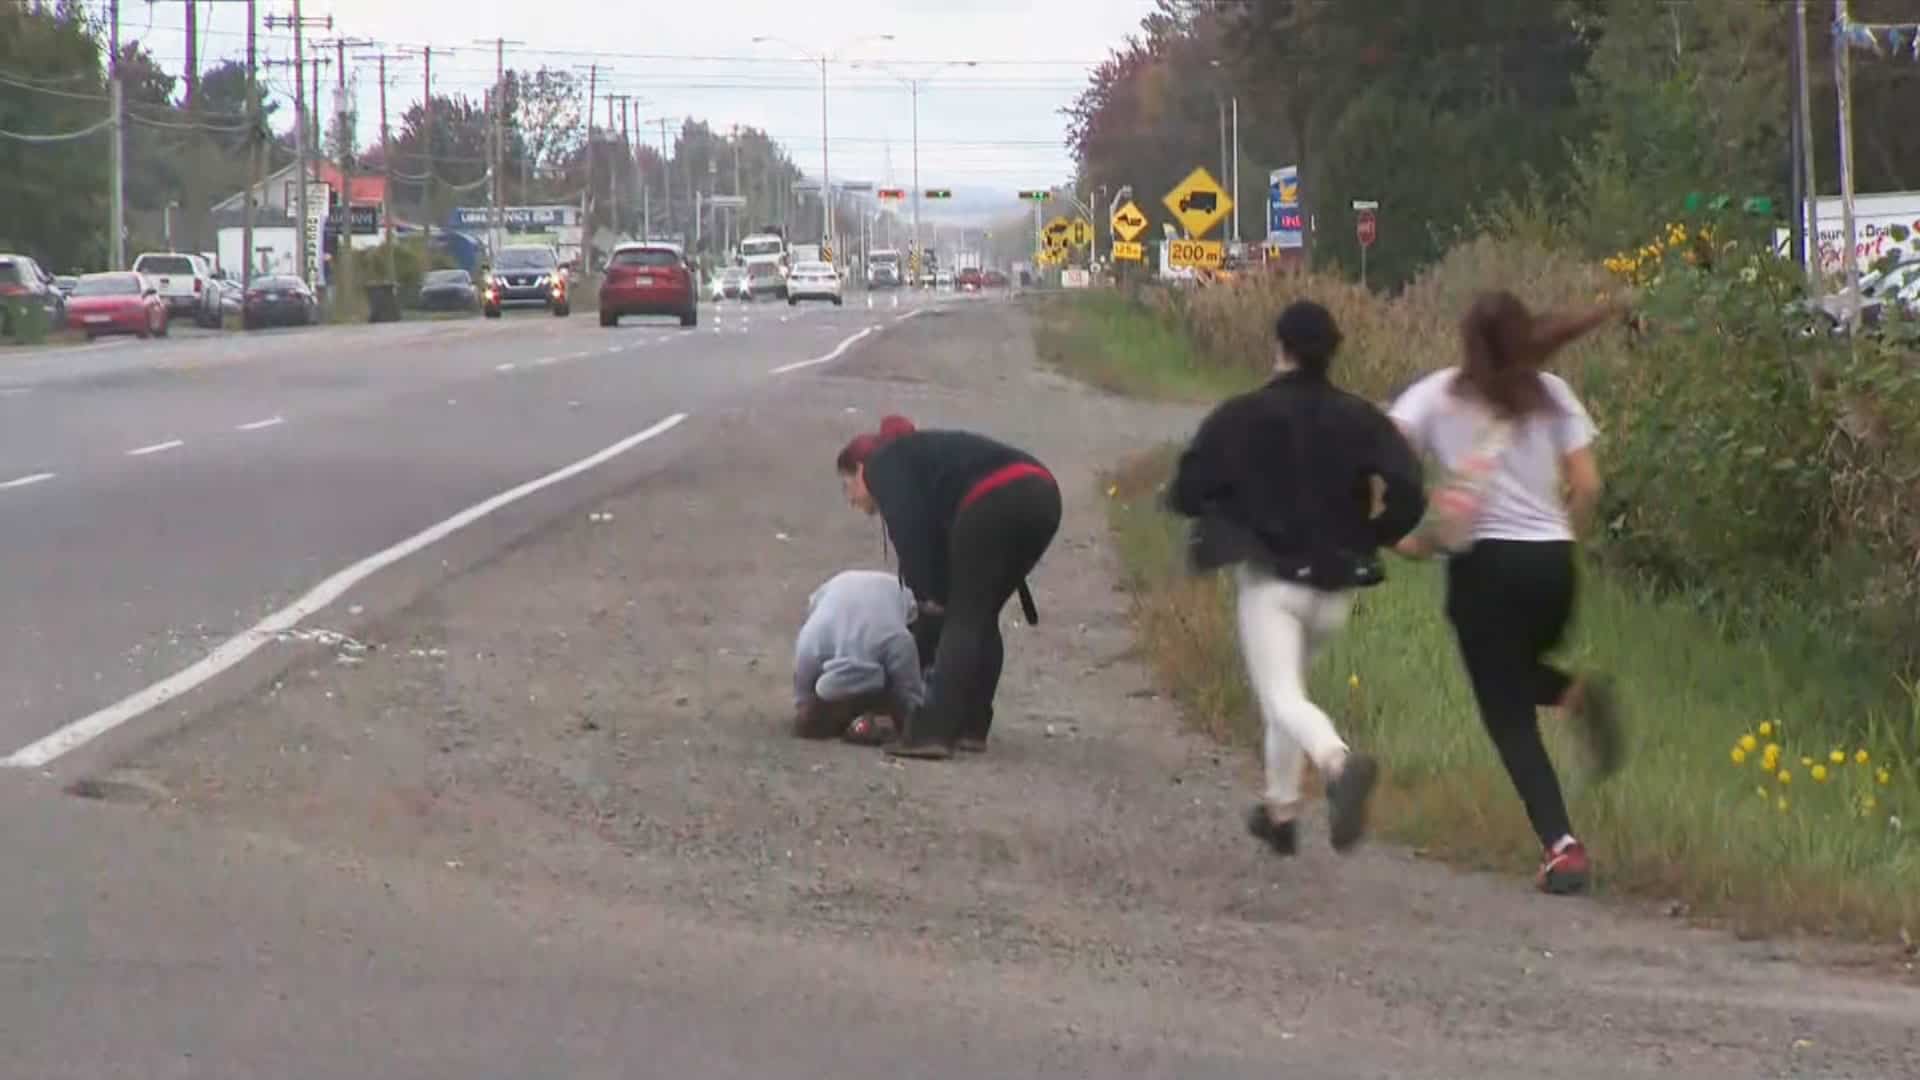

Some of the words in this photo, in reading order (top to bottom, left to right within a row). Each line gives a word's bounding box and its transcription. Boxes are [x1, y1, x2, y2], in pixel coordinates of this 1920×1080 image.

[1172, 244, 1204, 261] 200
[1206, 252, 1218, 261] m
[1818, 236, 1884, 263] Exert
